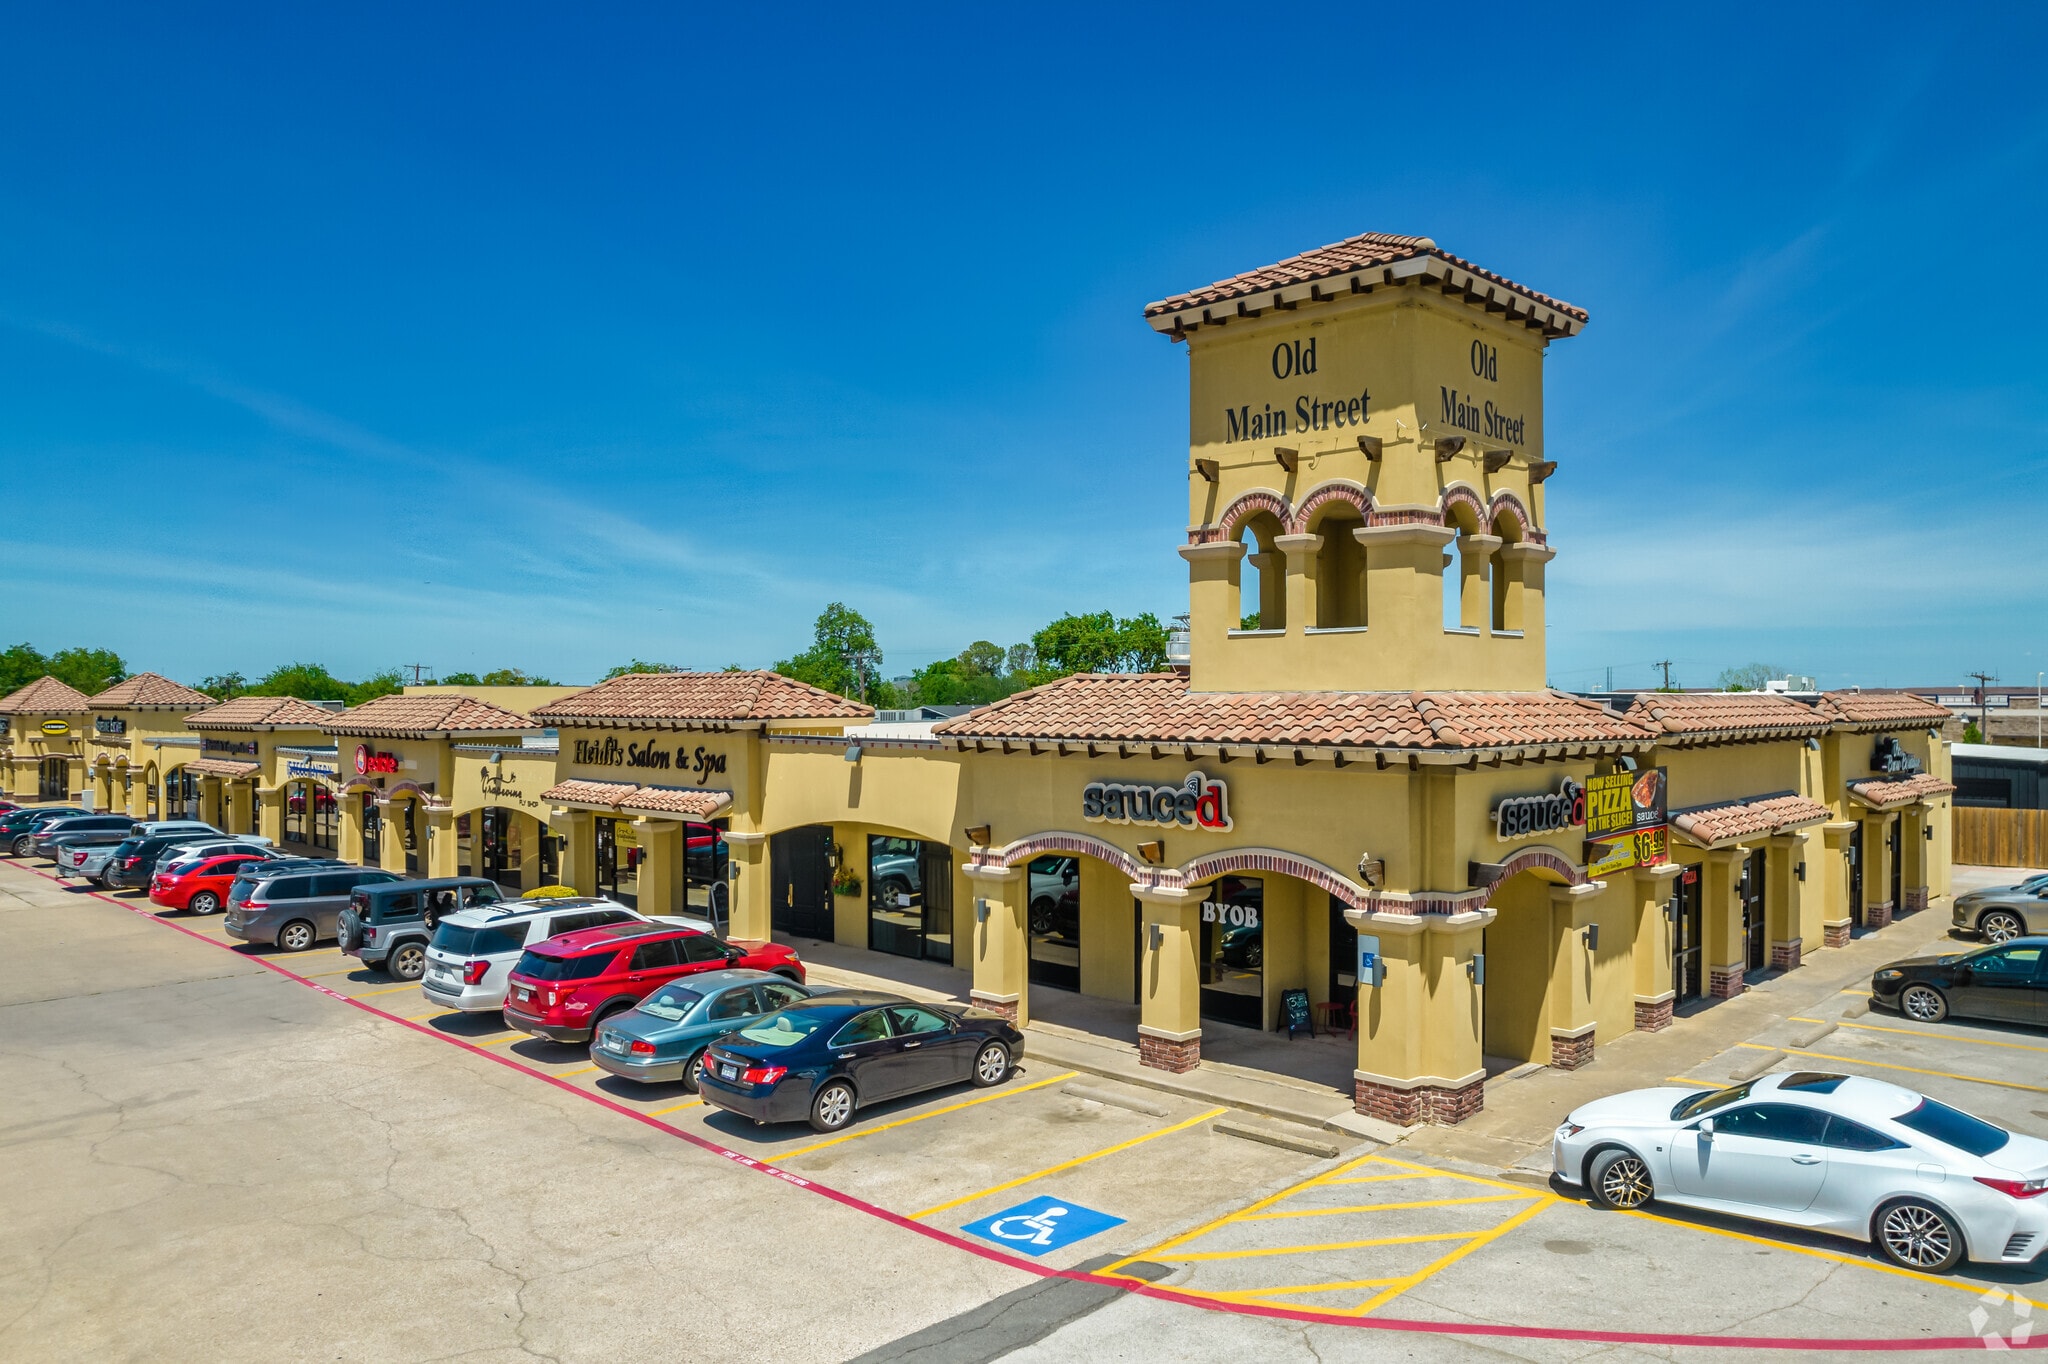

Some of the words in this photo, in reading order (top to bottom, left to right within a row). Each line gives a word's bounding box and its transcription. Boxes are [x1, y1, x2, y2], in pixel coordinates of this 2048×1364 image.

[1272, 337, 1318, 380] Old
[1470, 339, 1498, 383] Old
[1225, 403, 1288, 444] Main
[1295, 388, 1371, 434] Street
[1440, 385, 1480, 433] Main
[1484, 400, 1525, 445] Street
[573, 736, 624, 766] Heidi's
[627, 739, 670, 769] Salon
[676, 747, 689, 769] &
[693, 746, 727, 785] Spa
[1587, 776, 1604, 791] NOW
[1605, 773, 1633, 788] SELLING
[1587, 786, 1633, 818] PIZZA
[1588, 816, 1597, 833] BY
[1597, 814, 1610, 831] THE
[1610, 811, 1633, 828] SLICE!
[1202, 901, 1259, 928] BYOB
